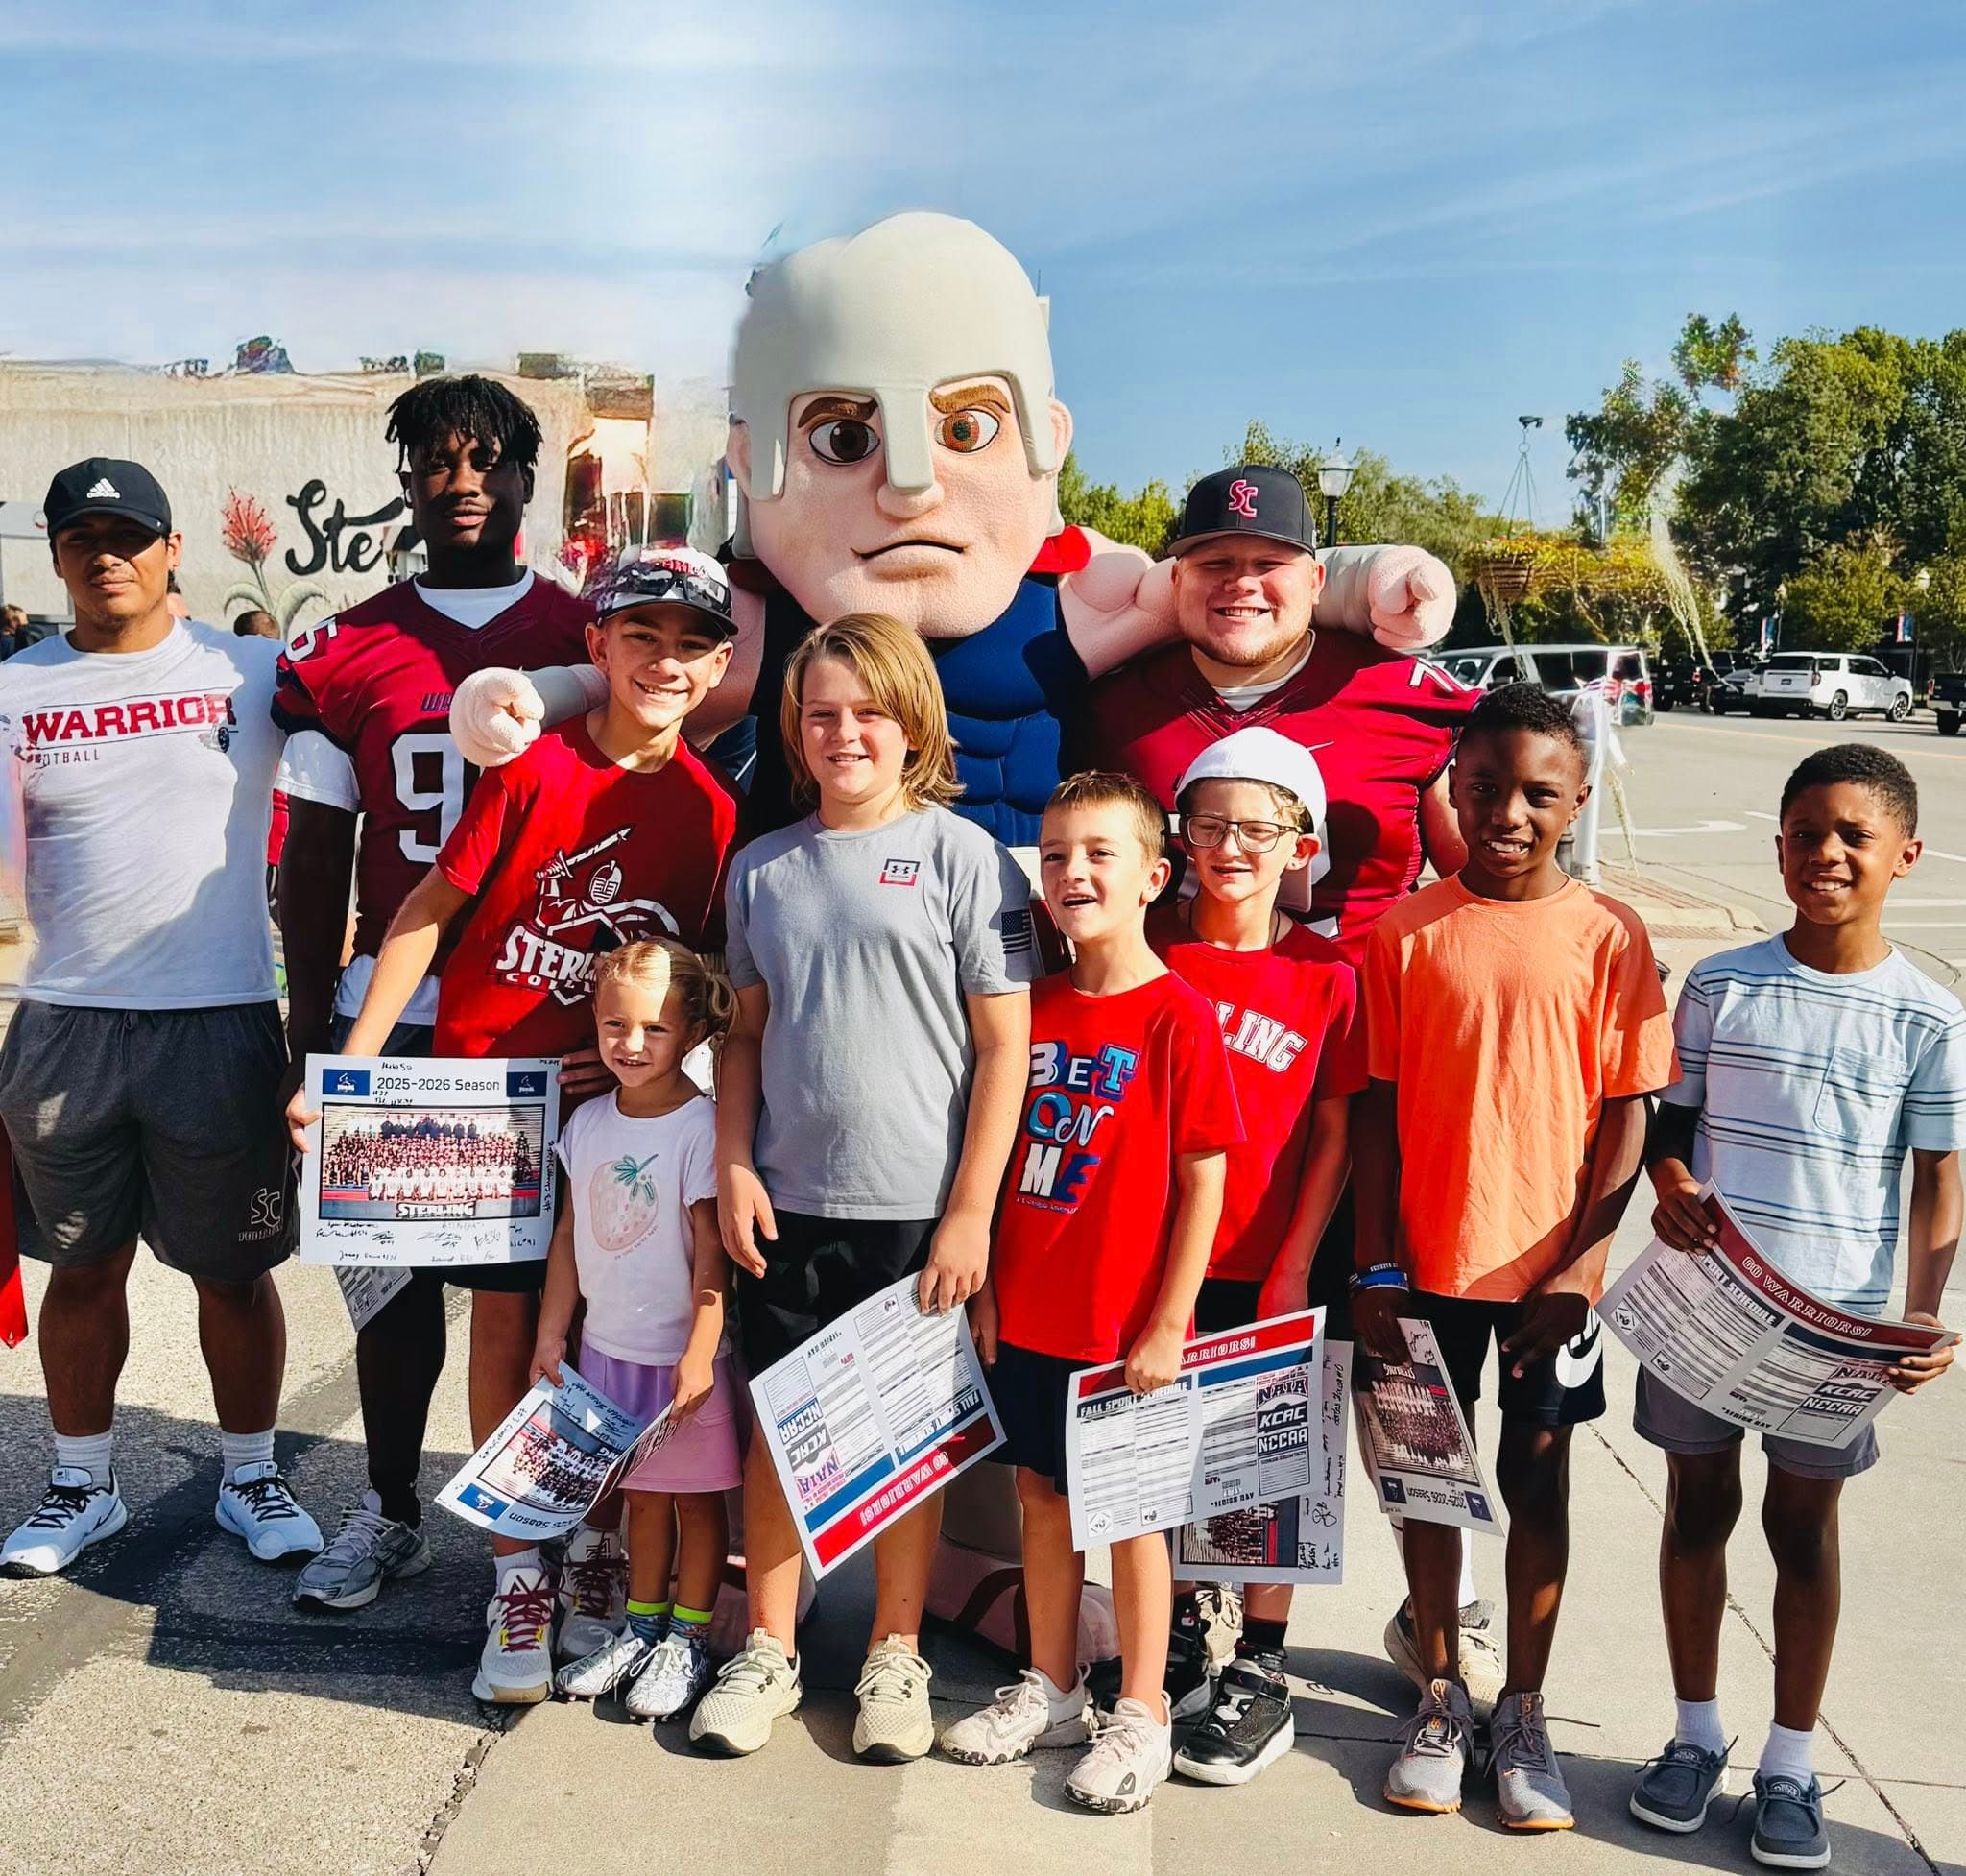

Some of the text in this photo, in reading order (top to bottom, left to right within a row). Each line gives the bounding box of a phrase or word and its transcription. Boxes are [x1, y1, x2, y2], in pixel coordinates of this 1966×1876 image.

[1229, 479, 1258, 518] SC
[285, 479, 405, 576] Ste
[376, 1076, 500, 1092] 2025-2026 Season
[1029, 1040, 1142, 1102] BET
[1026, 1091, 1115, 1147] ON
[1018, 1142, 1104, 1205] ME
[250, 1188, 281, 1228] SC
[1742, 1256, 1873, 1337] GO WARRIORS!
[1259, 1379, 1305, 1404] NAIA
[1802, 1397, 1865, 1417] NCCAA
[1819, 1384, 1876, 1400] KCAC
[1259, 1406, 1306, 1430] KCAC
[1258, 1428, 1307, 1454] NCCAA
[508, 1511, 551, 1529] Season
